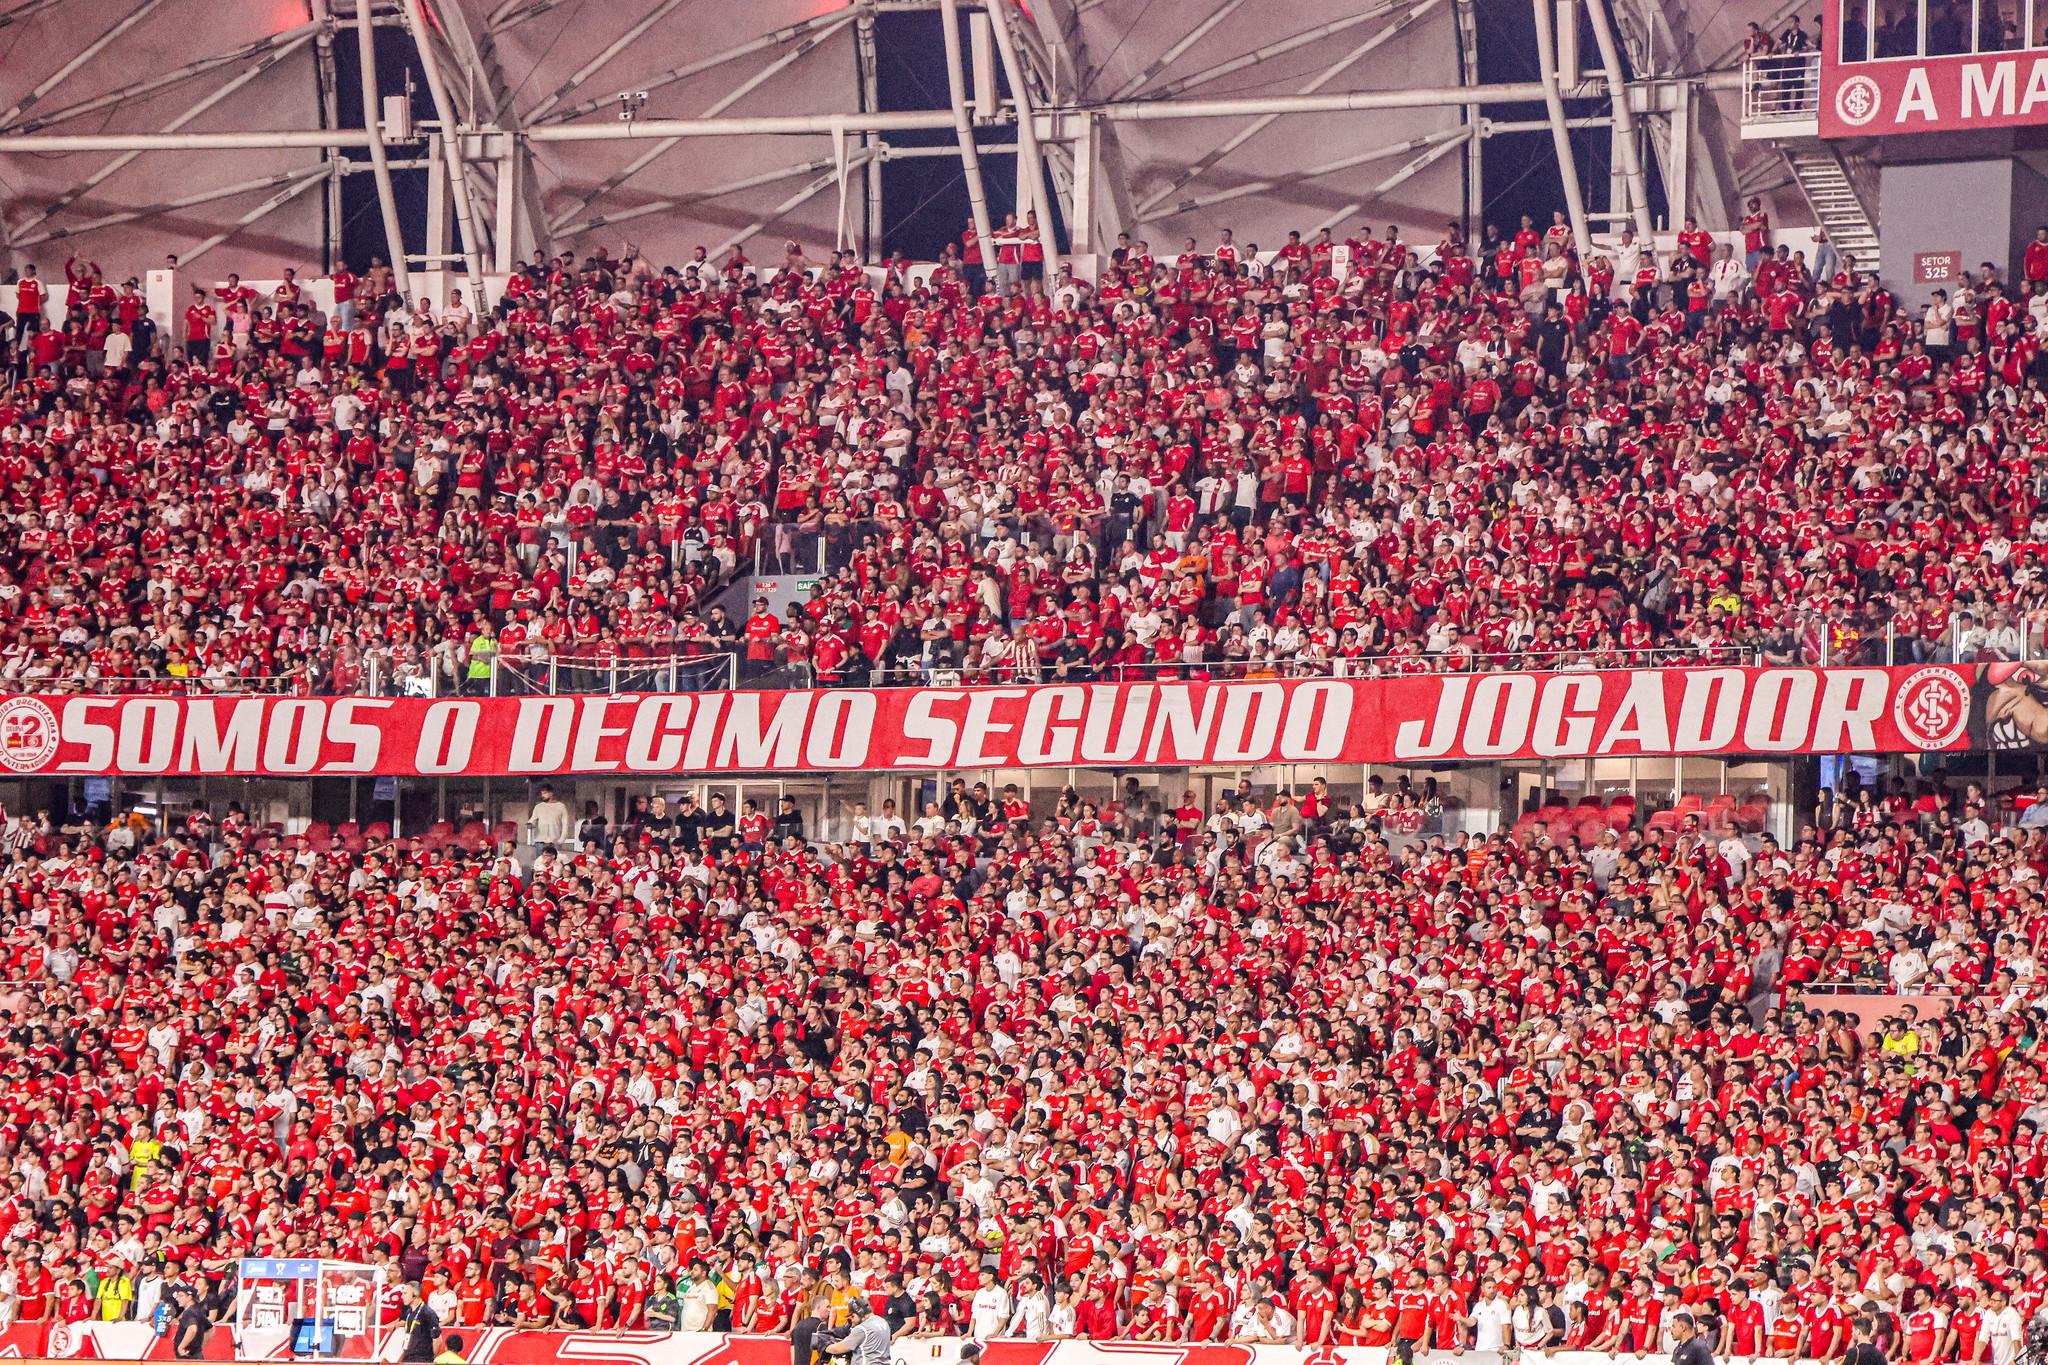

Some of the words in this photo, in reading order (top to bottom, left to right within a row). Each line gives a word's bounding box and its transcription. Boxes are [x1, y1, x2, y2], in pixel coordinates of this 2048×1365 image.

[1895, 68, 1938, 123] A
[1921, 256, 1951, 267] SETOR
[1925, 267, 1948, 279] 325
[57, 697, 394, 773] SOMOS
[415, 701, 480, 773] O
[508, 690, 877, 772] DÉCIMO
[892, 681, 1353, 768] SEGUNDO
[1395, 669, 1890, 759] JOGADOR
